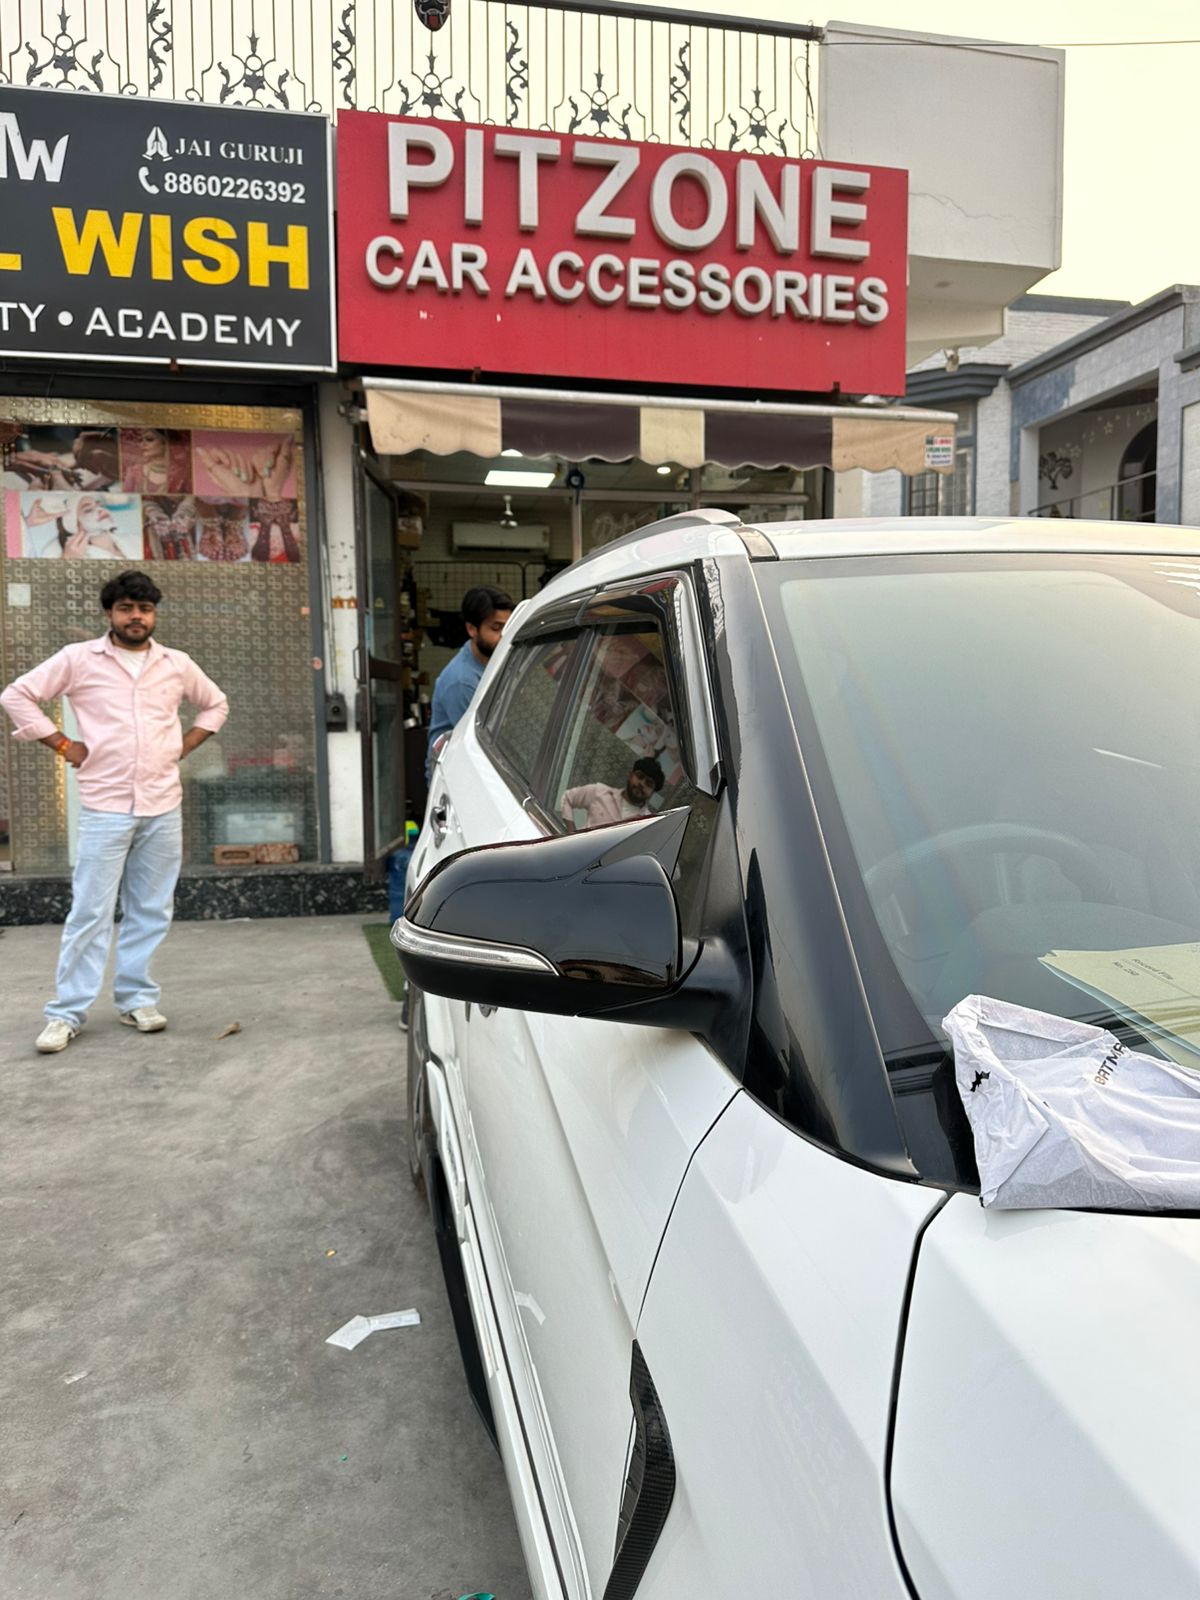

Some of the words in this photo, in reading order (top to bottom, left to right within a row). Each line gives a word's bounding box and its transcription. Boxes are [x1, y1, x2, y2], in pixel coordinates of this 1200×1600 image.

[175, 137, 211, 157] JAI
[219, 141, 304, 165] GURUJI
[163, 172, 306, 204] 8860226392
[387, 121, 872, 262] PITZONE
[51, 206, 310, 291] WISH
[365, 235, 491, 296] CAR
[505, 247, 890, 326] ACCESSORIES
[84, 306, 302, 348] ACADEMY
